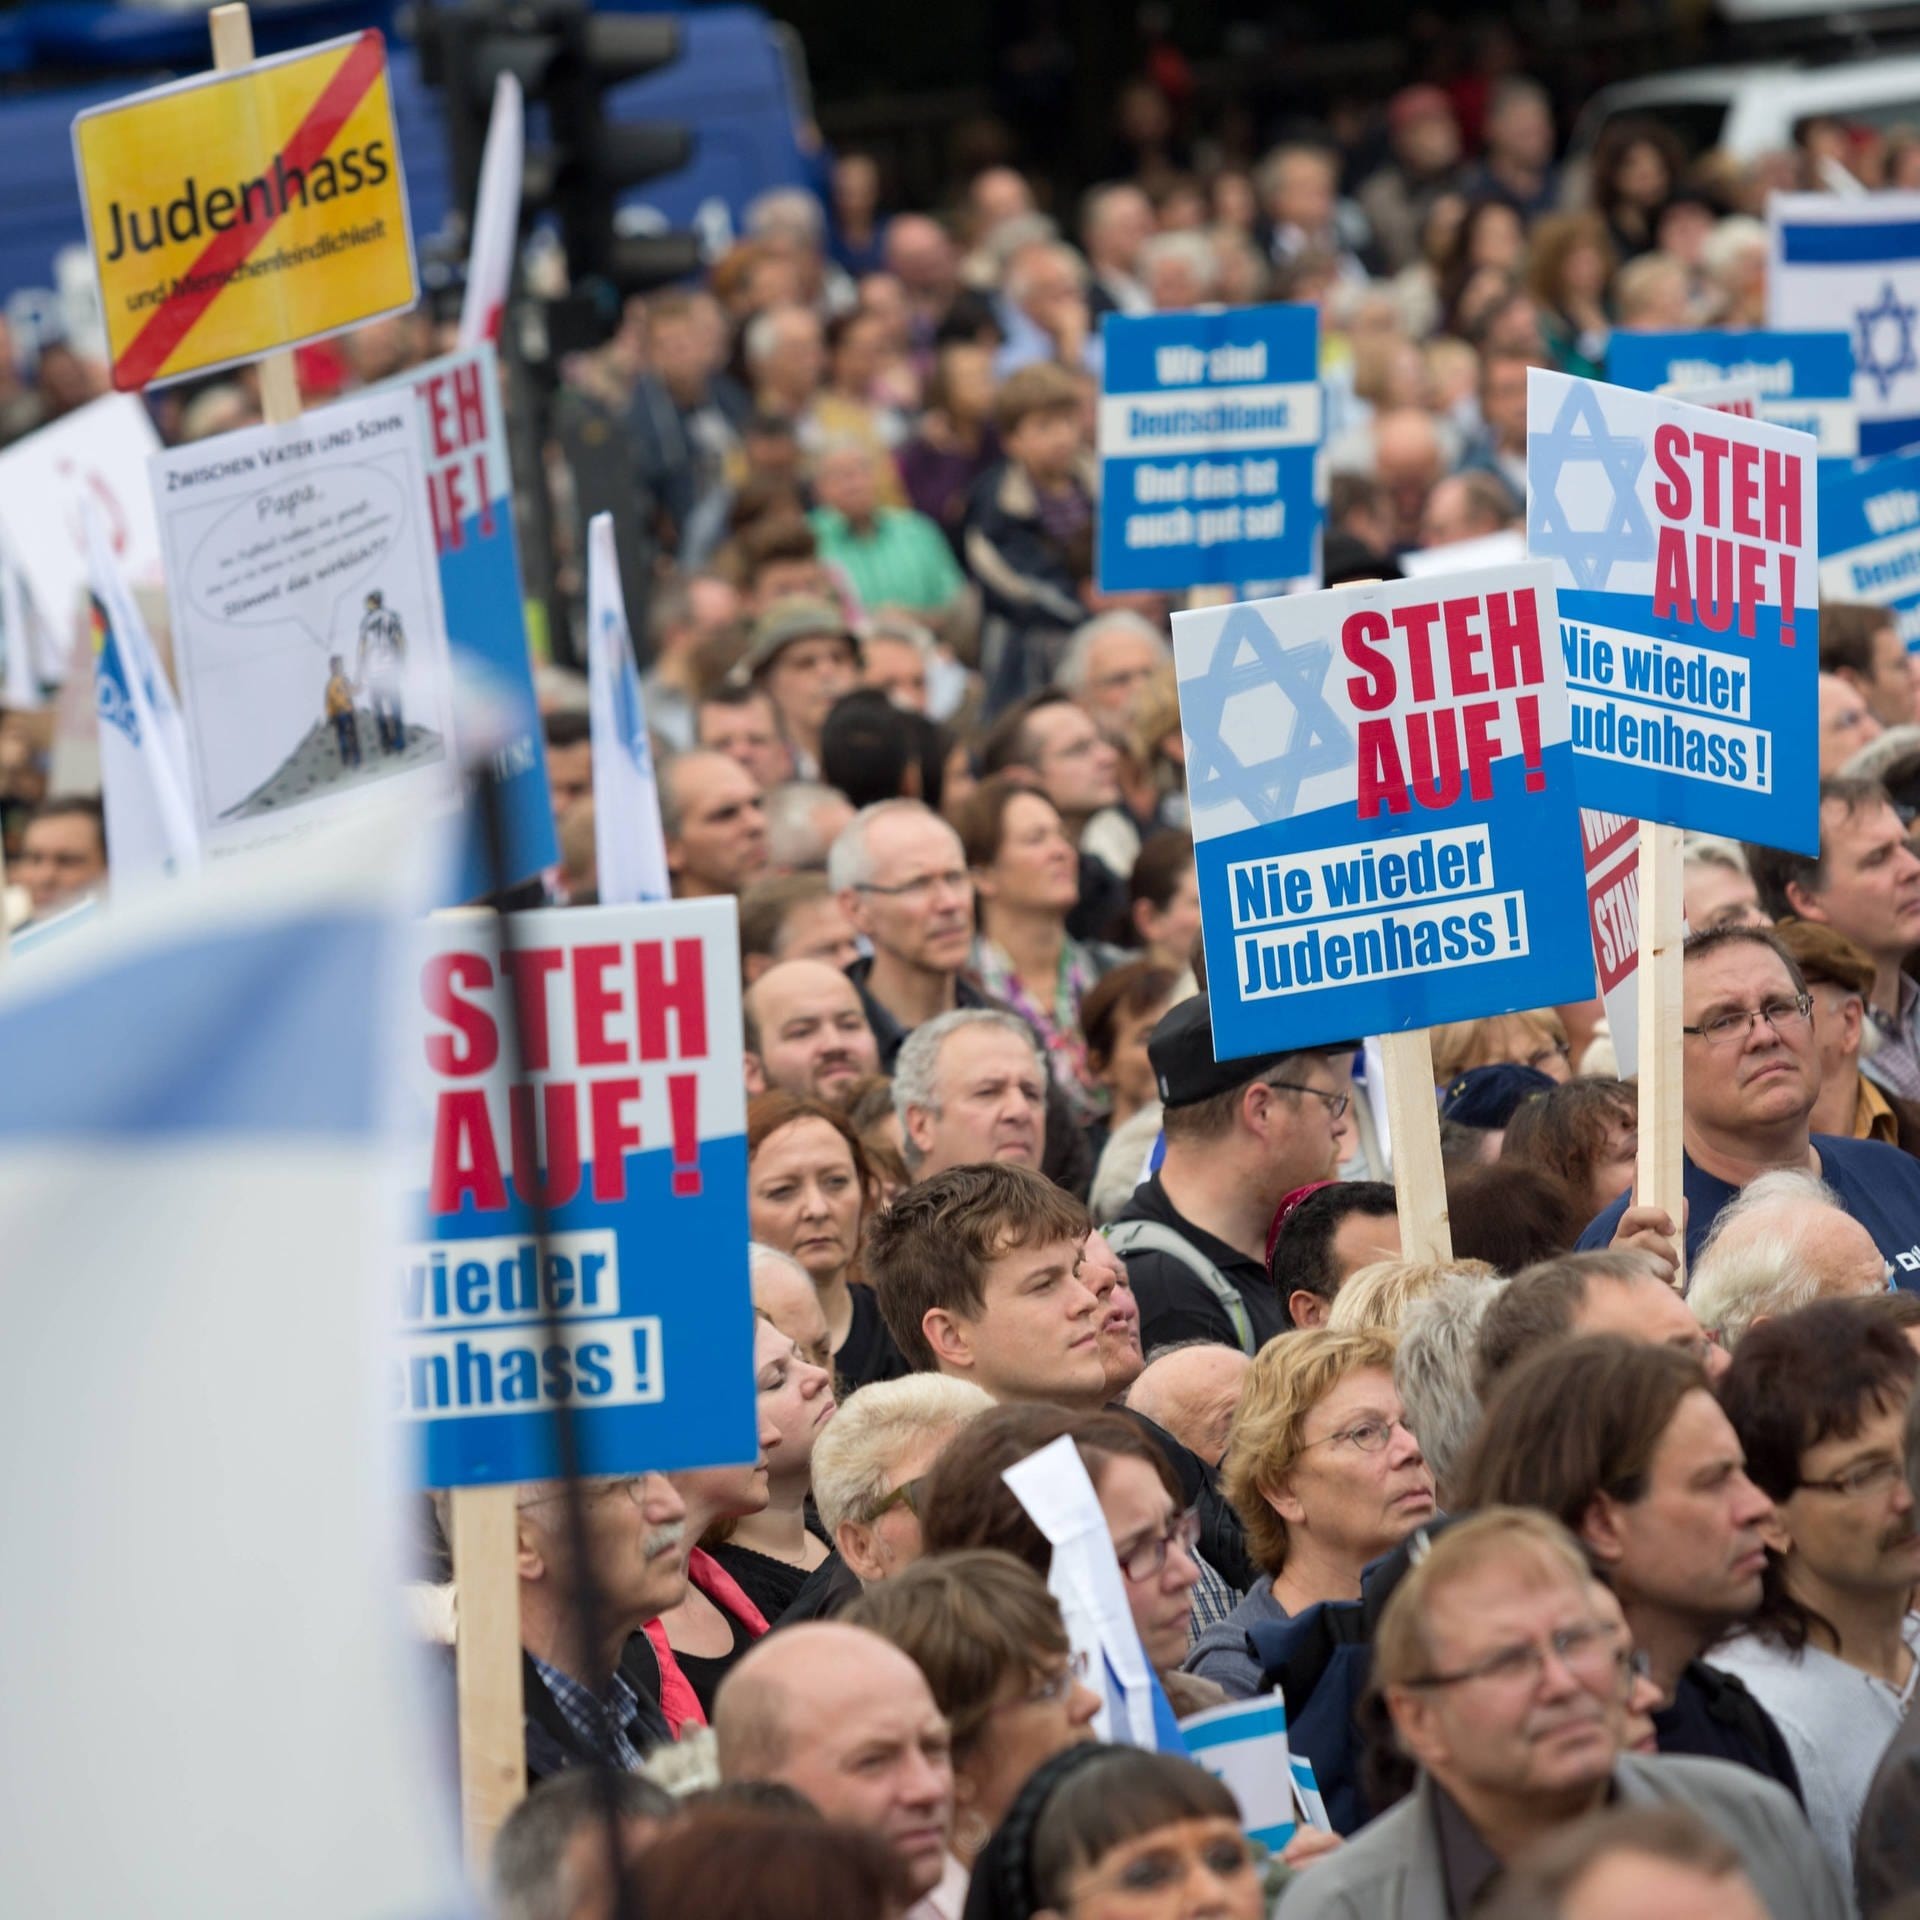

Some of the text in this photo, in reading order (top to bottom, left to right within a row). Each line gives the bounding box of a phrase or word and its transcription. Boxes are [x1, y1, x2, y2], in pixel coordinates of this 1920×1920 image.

[107, 140, 389, 263] Judenhass
[126, 217, 388, 313] und Menschenfeindlichkeit
[1130, 401, 1288, 439] Deutschland
[1653, 423, 1803, 549] STEH
[1341, 587, 1545, 712] STEH
[1621, 643, 1746, 713] wieder
[1571, 701, 1748, 783] udenhass
[1234, 838, 1486, 922] Nie wieder
[1244, 911, 1497, 995] Judenhass
[419, 938, 709, 1080] STEH
